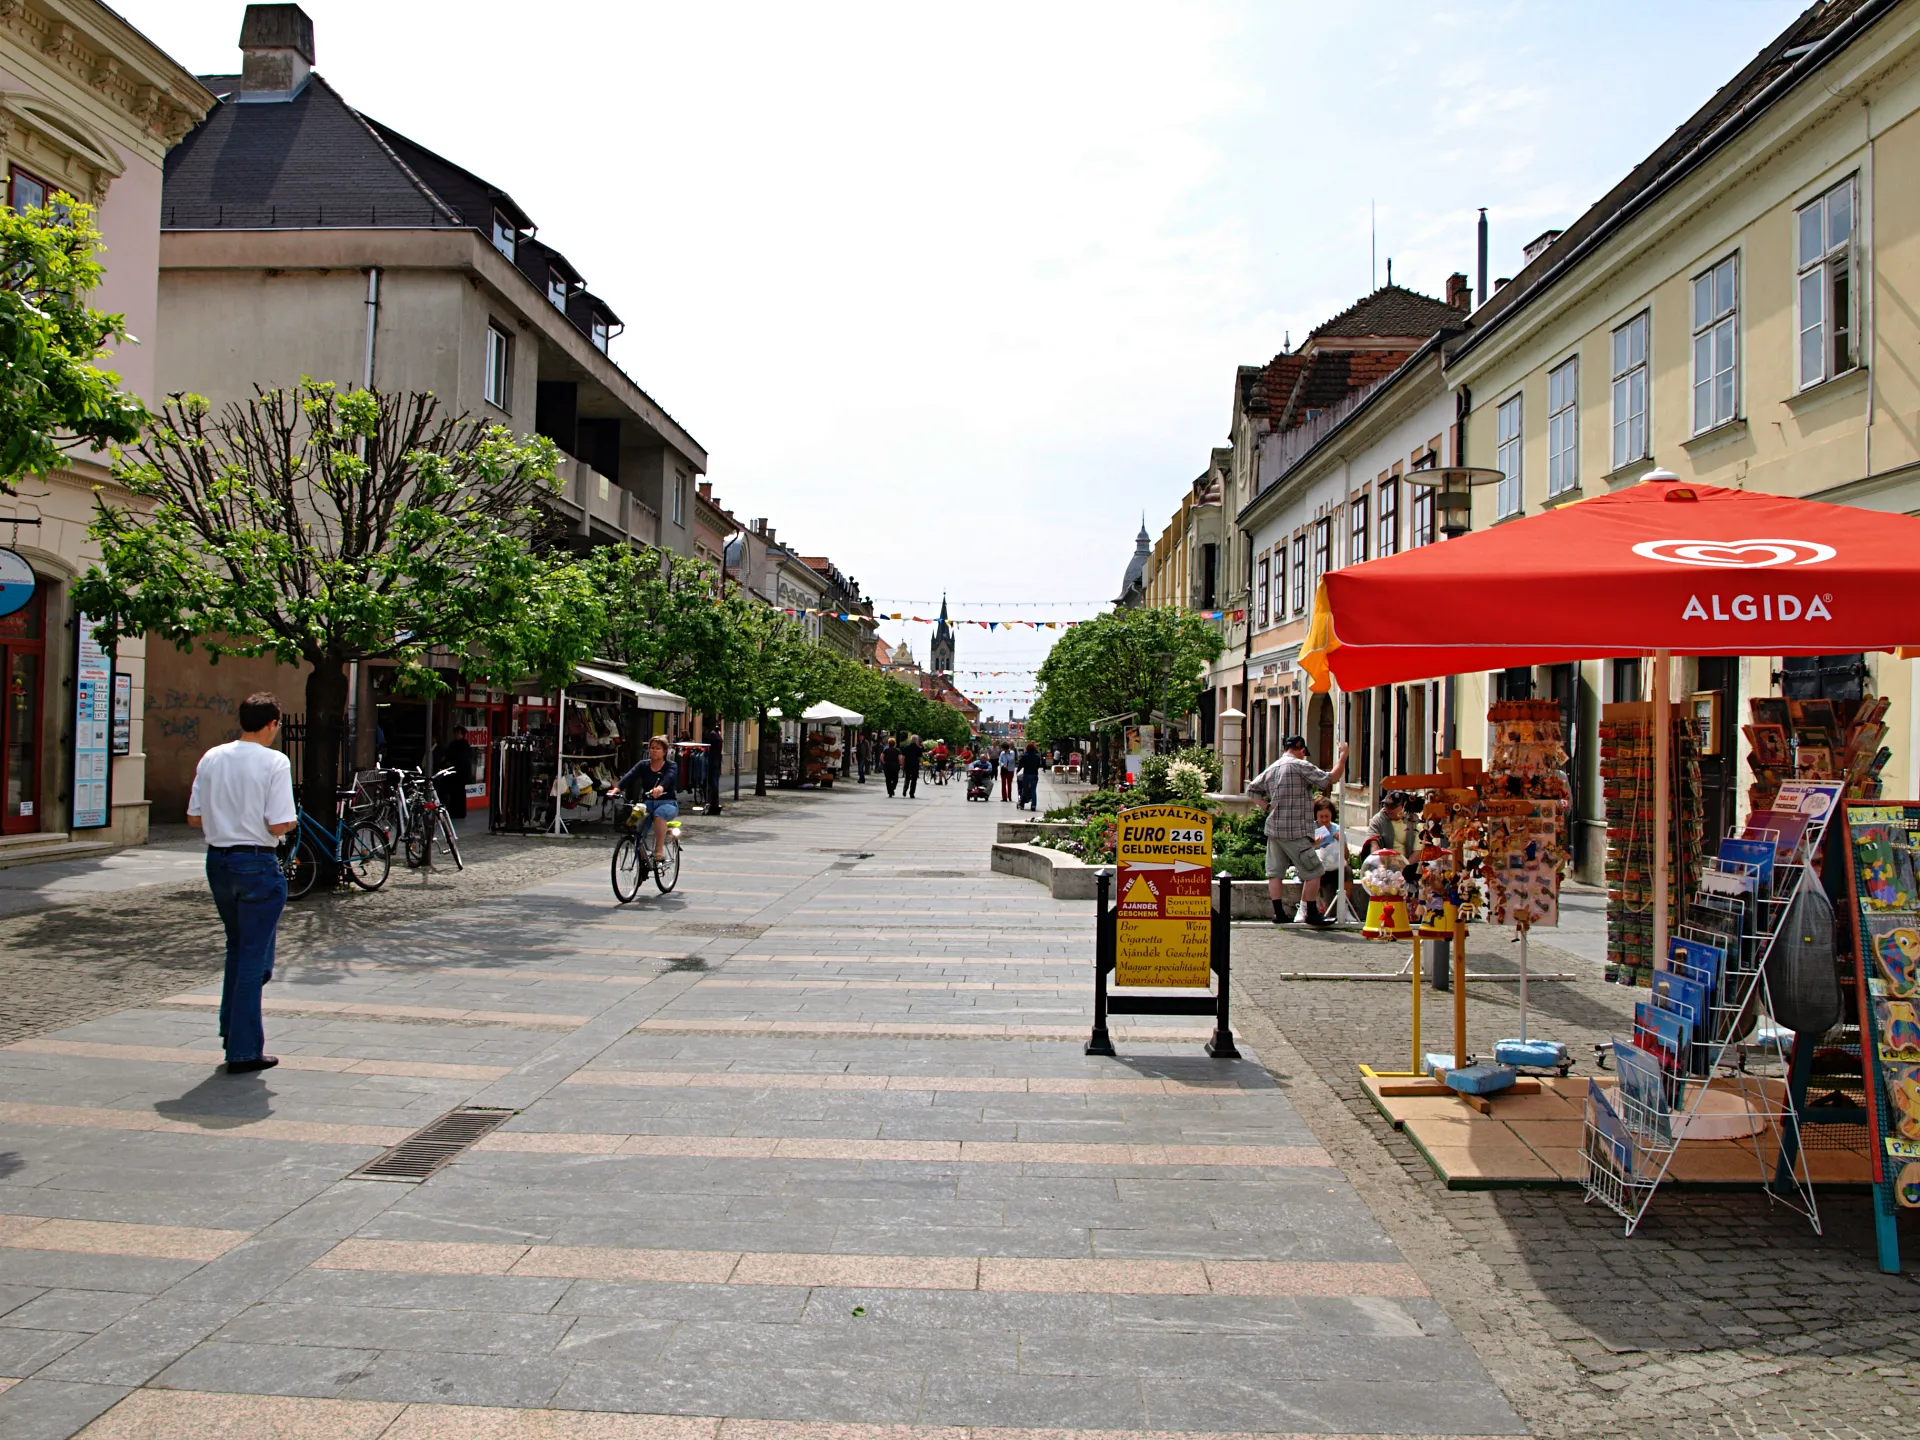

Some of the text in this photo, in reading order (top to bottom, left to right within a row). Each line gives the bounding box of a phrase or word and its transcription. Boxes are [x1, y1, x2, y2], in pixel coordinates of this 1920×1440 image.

[1123, 808, 1208, 825] PÉNZVÁLTÁS
[1123, 827, 1203, 842] EURO 246
[1122, 844, 1207, 855] GELDWECHSEL
[1169, 873, 1207, 884] Ajándék
[1122, 877, 1136, 893] TRE
[1146, 880, 1160, 896] HOP
[1176, 884, 1200, 896] Üzlet
[1122, 902, 1158, 910] AJÁNDÉK
[1167, 897, 1208, 906] Souvenir
[1166, 906, 1210, 916] Geschenk
[1120, 921, 1207, 931] Bor Wein
[1119, 932, 1209, 946] Cigaretta Tabak
[1120, 946, 1209, 959] Ajándék Geschenk
[1119, 960, 1207, 973] Magyar specialitások
